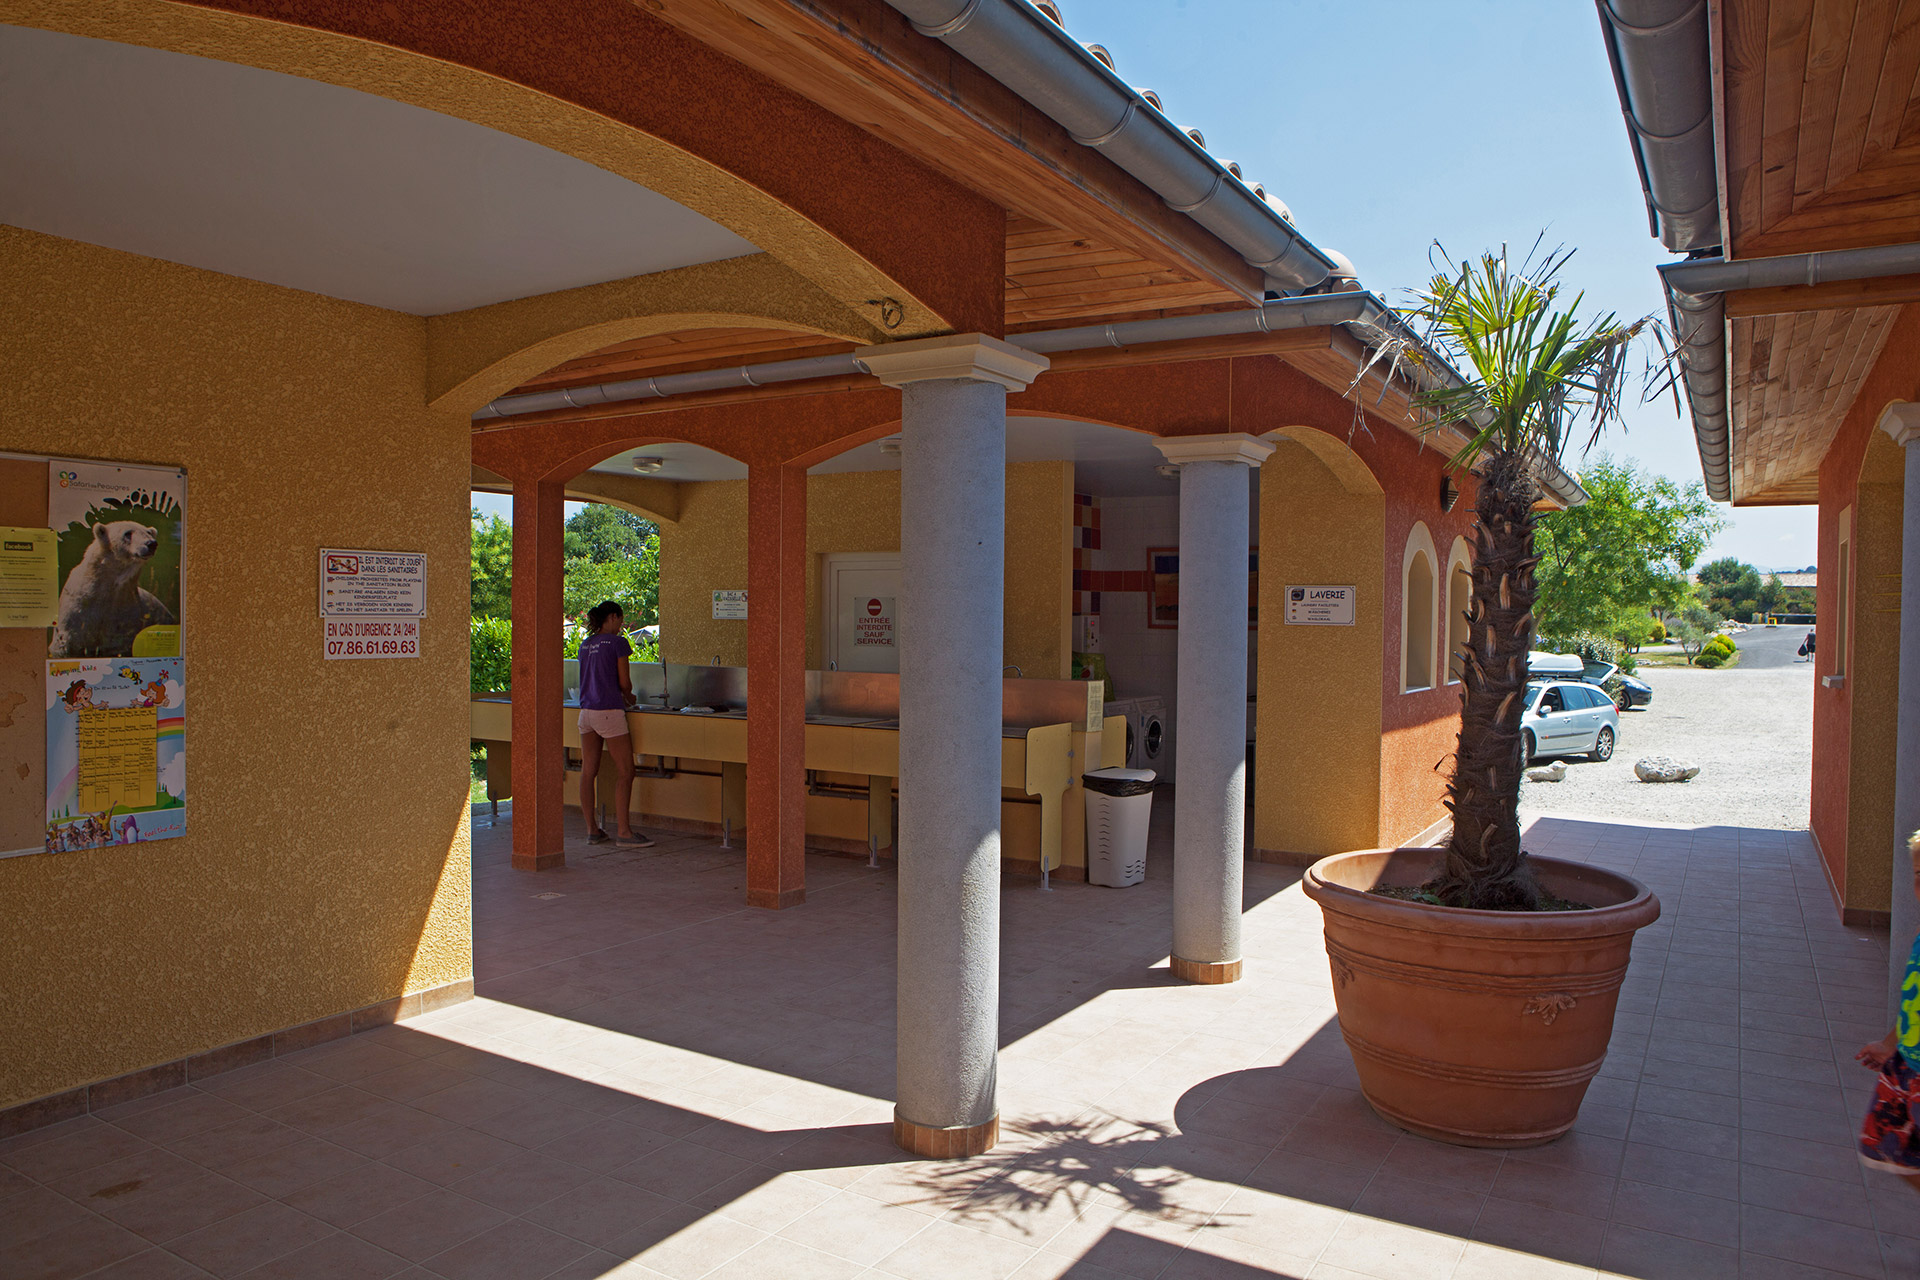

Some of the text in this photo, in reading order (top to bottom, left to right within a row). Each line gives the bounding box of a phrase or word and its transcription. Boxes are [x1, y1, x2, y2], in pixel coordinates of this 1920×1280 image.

[365, 556, 374, 564] EST
[376, 557, 398, 566] INTERDIT
[406, 558, 421, 566] JOUER
[1310, 591, 1345, 599] LAVERIE
[328, 623, 337, 636] EN
[340, 623, 353, 636] CAS
[355, 623, 391, 636] D'URGENCE
[328, 640, 416, 655] 07.86.61.69.63
